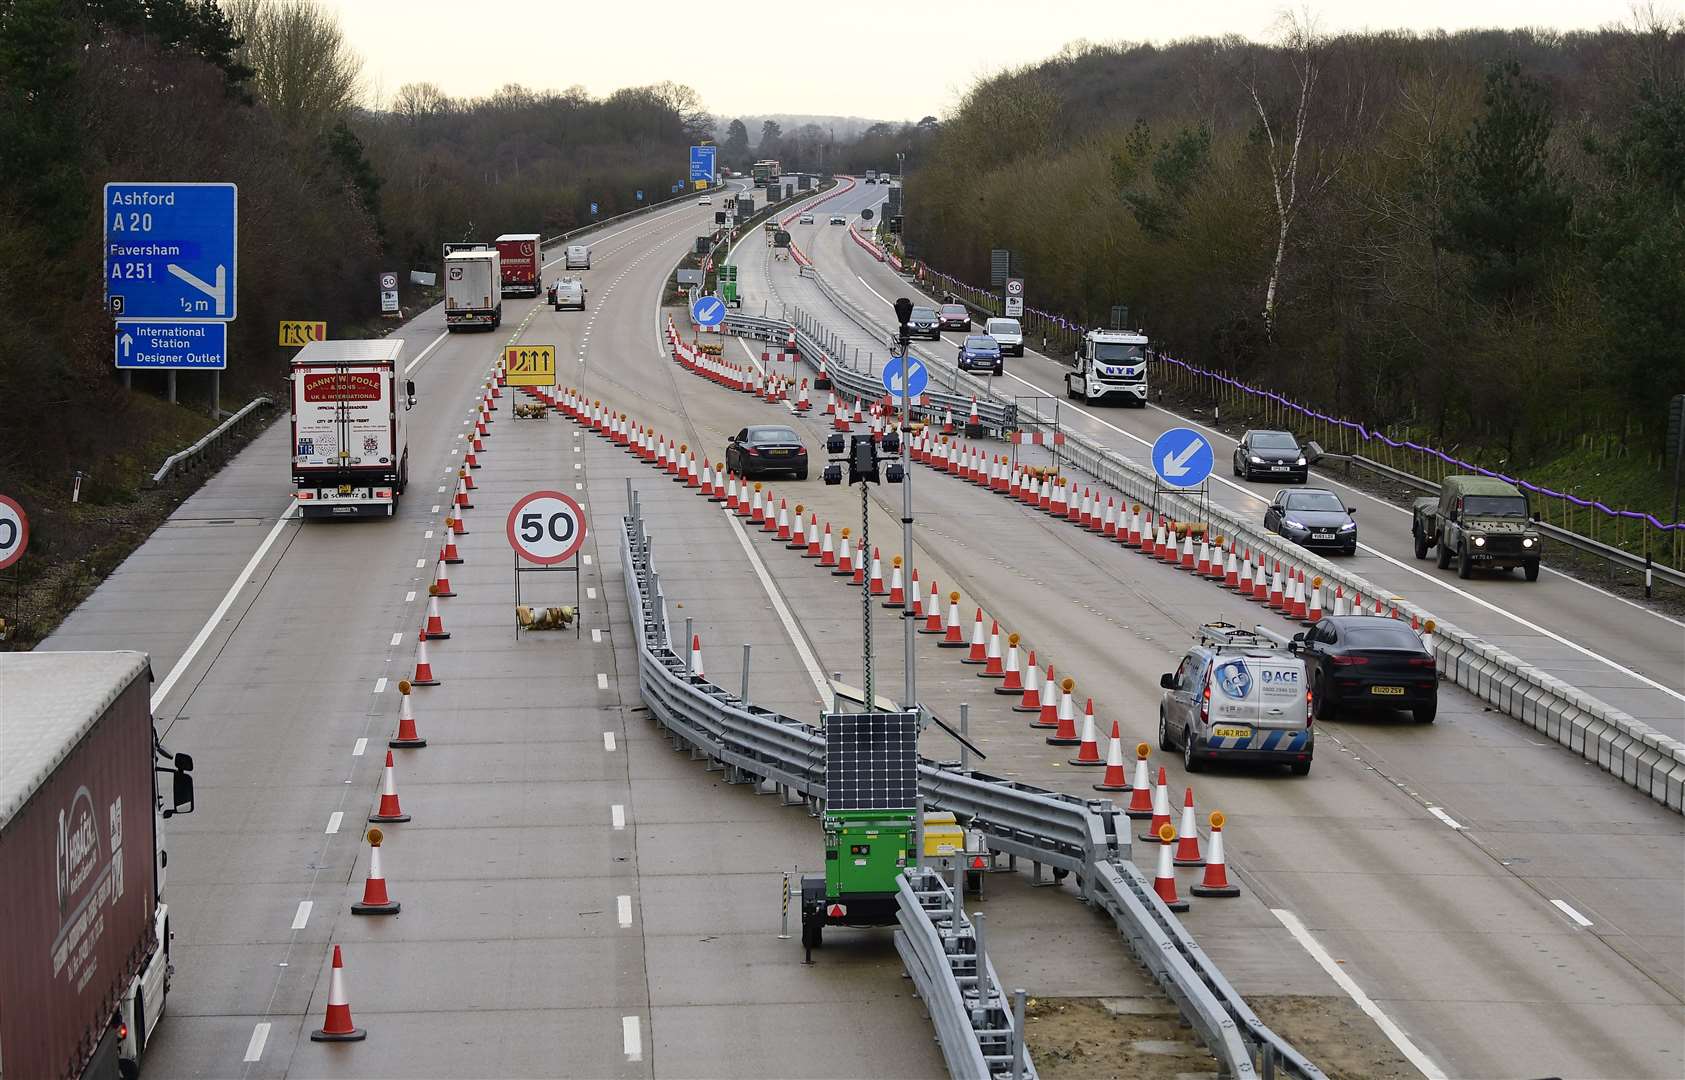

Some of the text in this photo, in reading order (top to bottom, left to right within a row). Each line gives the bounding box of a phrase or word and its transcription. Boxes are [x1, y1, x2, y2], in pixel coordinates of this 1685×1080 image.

[112, 192, 175, 205] Ashford
[110, 244, 179, 256] Faversham
[113, 299, 121, 311] 9
[136, 327, 205, 337] International
[151, 339, 190, 348] Station
[136, 353, 220, 364] Designer Outlet
[1106, 367, 1135, 376] NYR
[306, 376, 336, 391] DANNY
[351, 376, 379, 390] POOLE
[300, 445, 314, 453] TIR
[521, 512, 574, 543] 50
[1274, 671, 1298, 682] ACE
